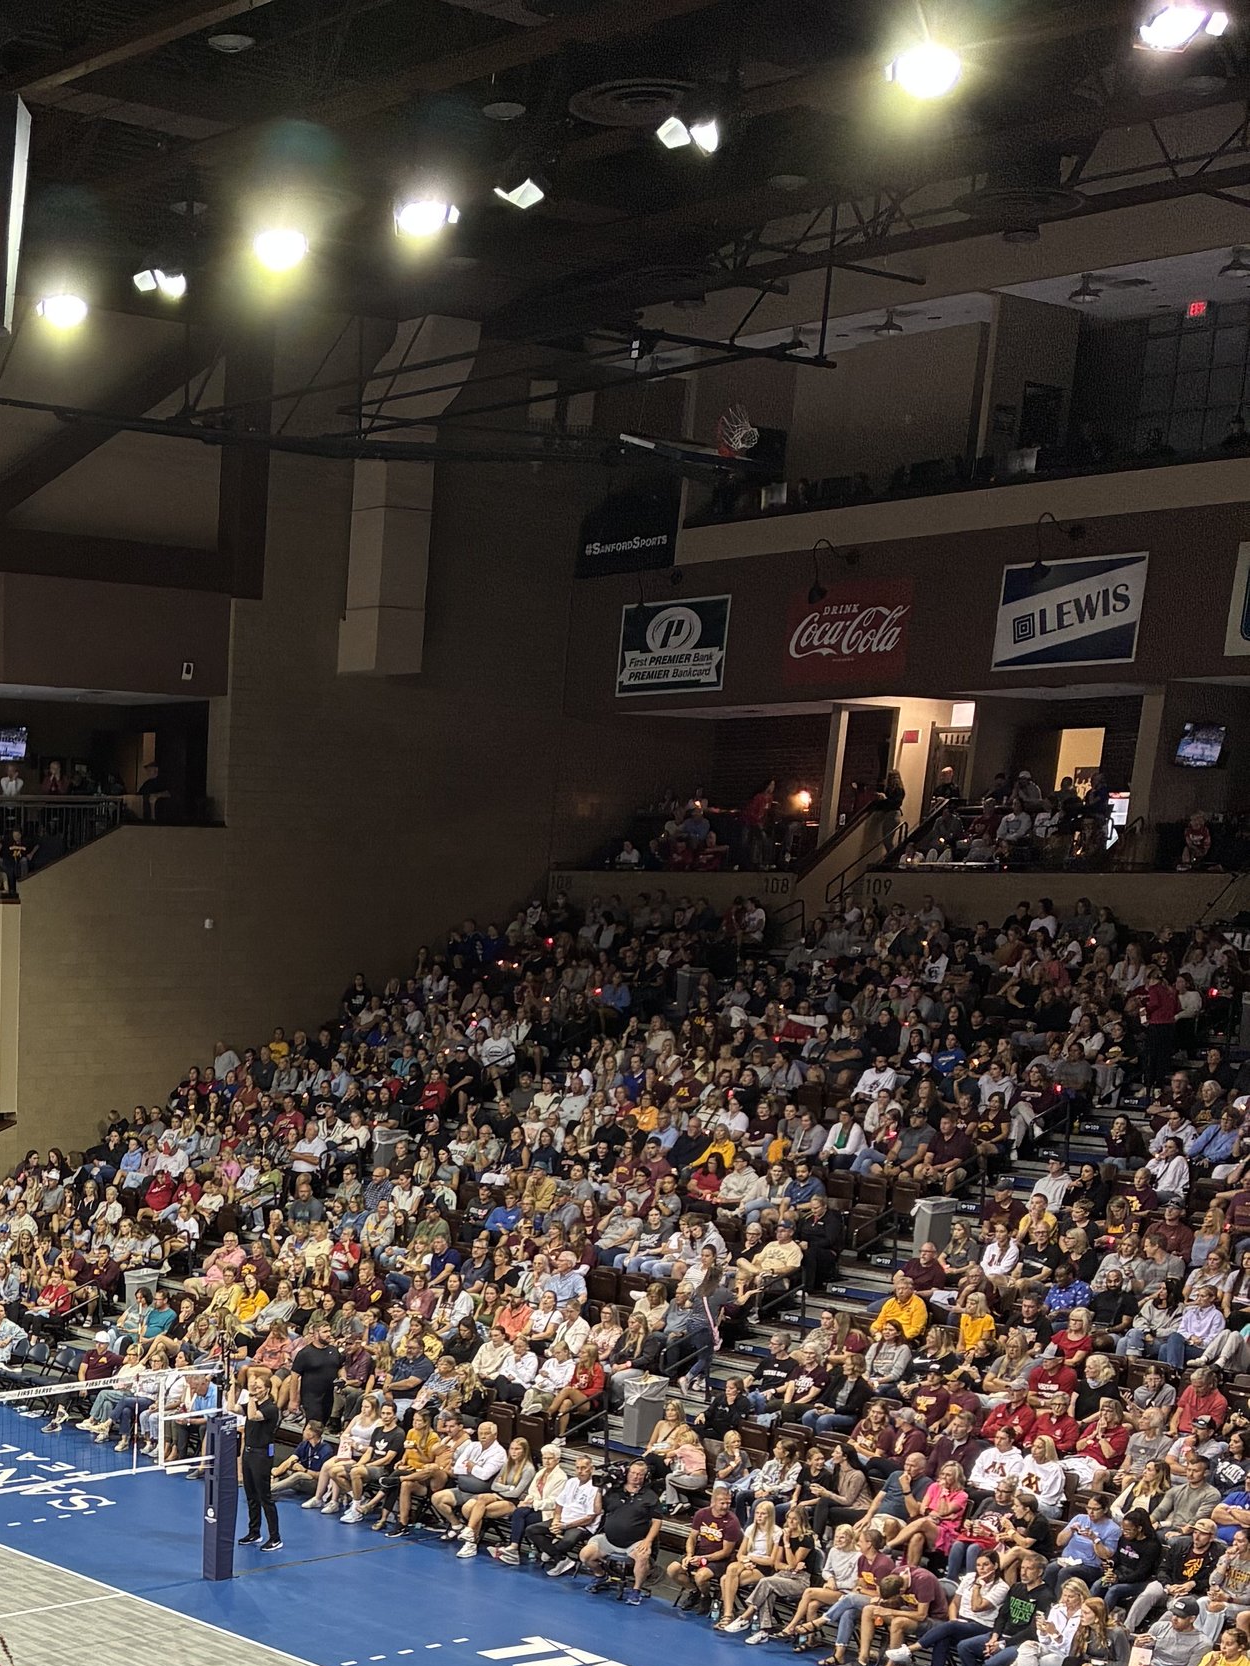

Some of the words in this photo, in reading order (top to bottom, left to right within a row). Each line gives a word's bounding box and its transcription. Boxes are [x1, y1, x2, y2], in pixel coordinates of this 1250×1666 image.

[822, 603, 860, 616] DRINK
[1039, 583, 1131, 636] LEWIS
[628, 656, 647, 668] First
[649, 653, 691, 666] PREMIER
[693, 651, 714, 664] Bank
[628, 668, 670, 681] PREMIER
[672, 665, 711, 679] Bankcard
[763, 877, 790, 895] 108
[864, 878, 893, 895] 109
